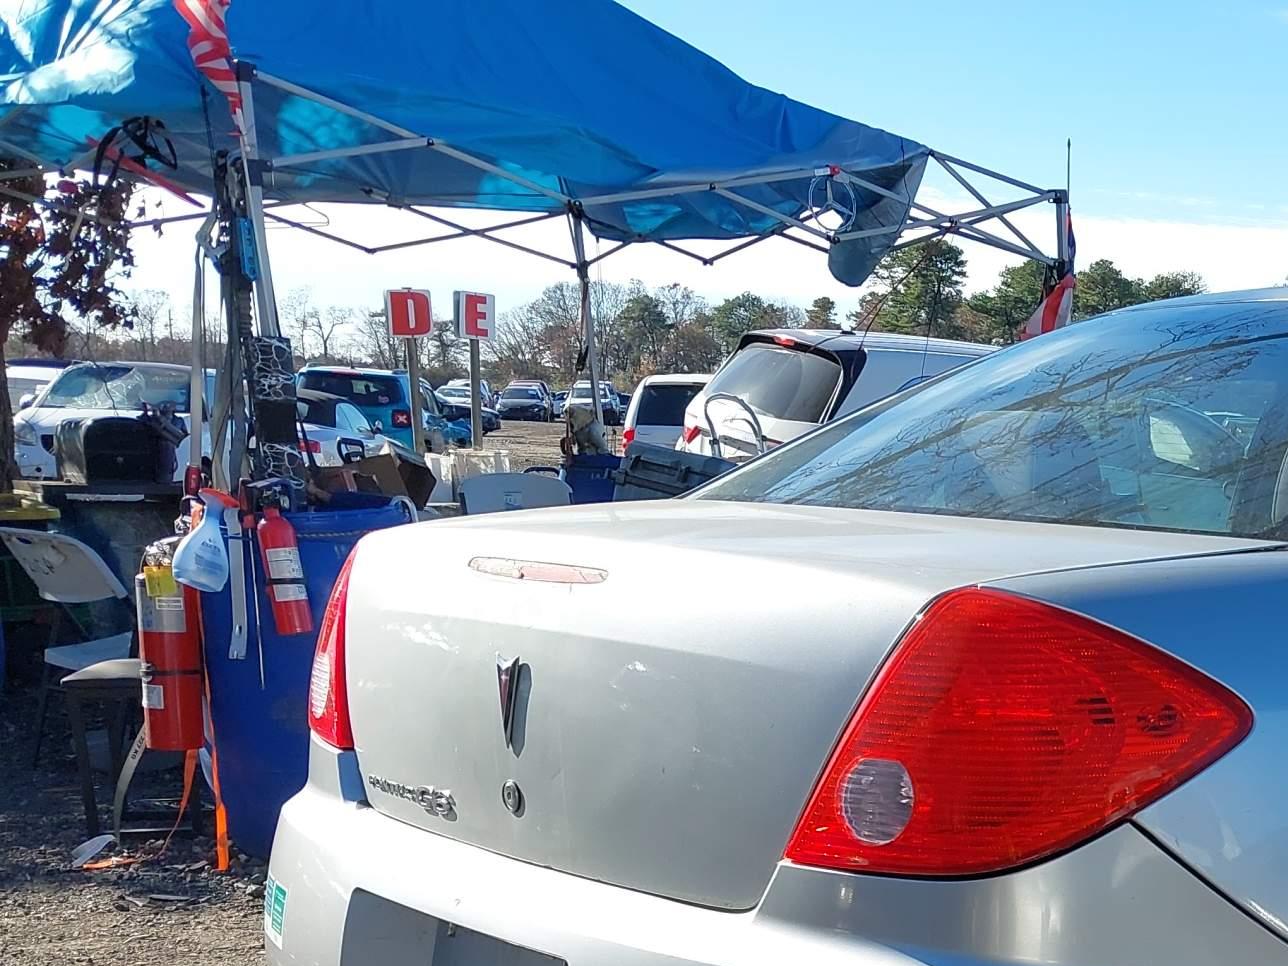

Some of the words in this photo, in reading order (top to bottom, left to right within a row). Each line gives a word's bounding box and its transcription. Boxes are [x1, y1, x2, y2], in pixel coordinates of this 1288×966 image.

[390, 291, 430, 336] D
[465, 294, 489, 337] E
[416, 787, 452, 814] G6
